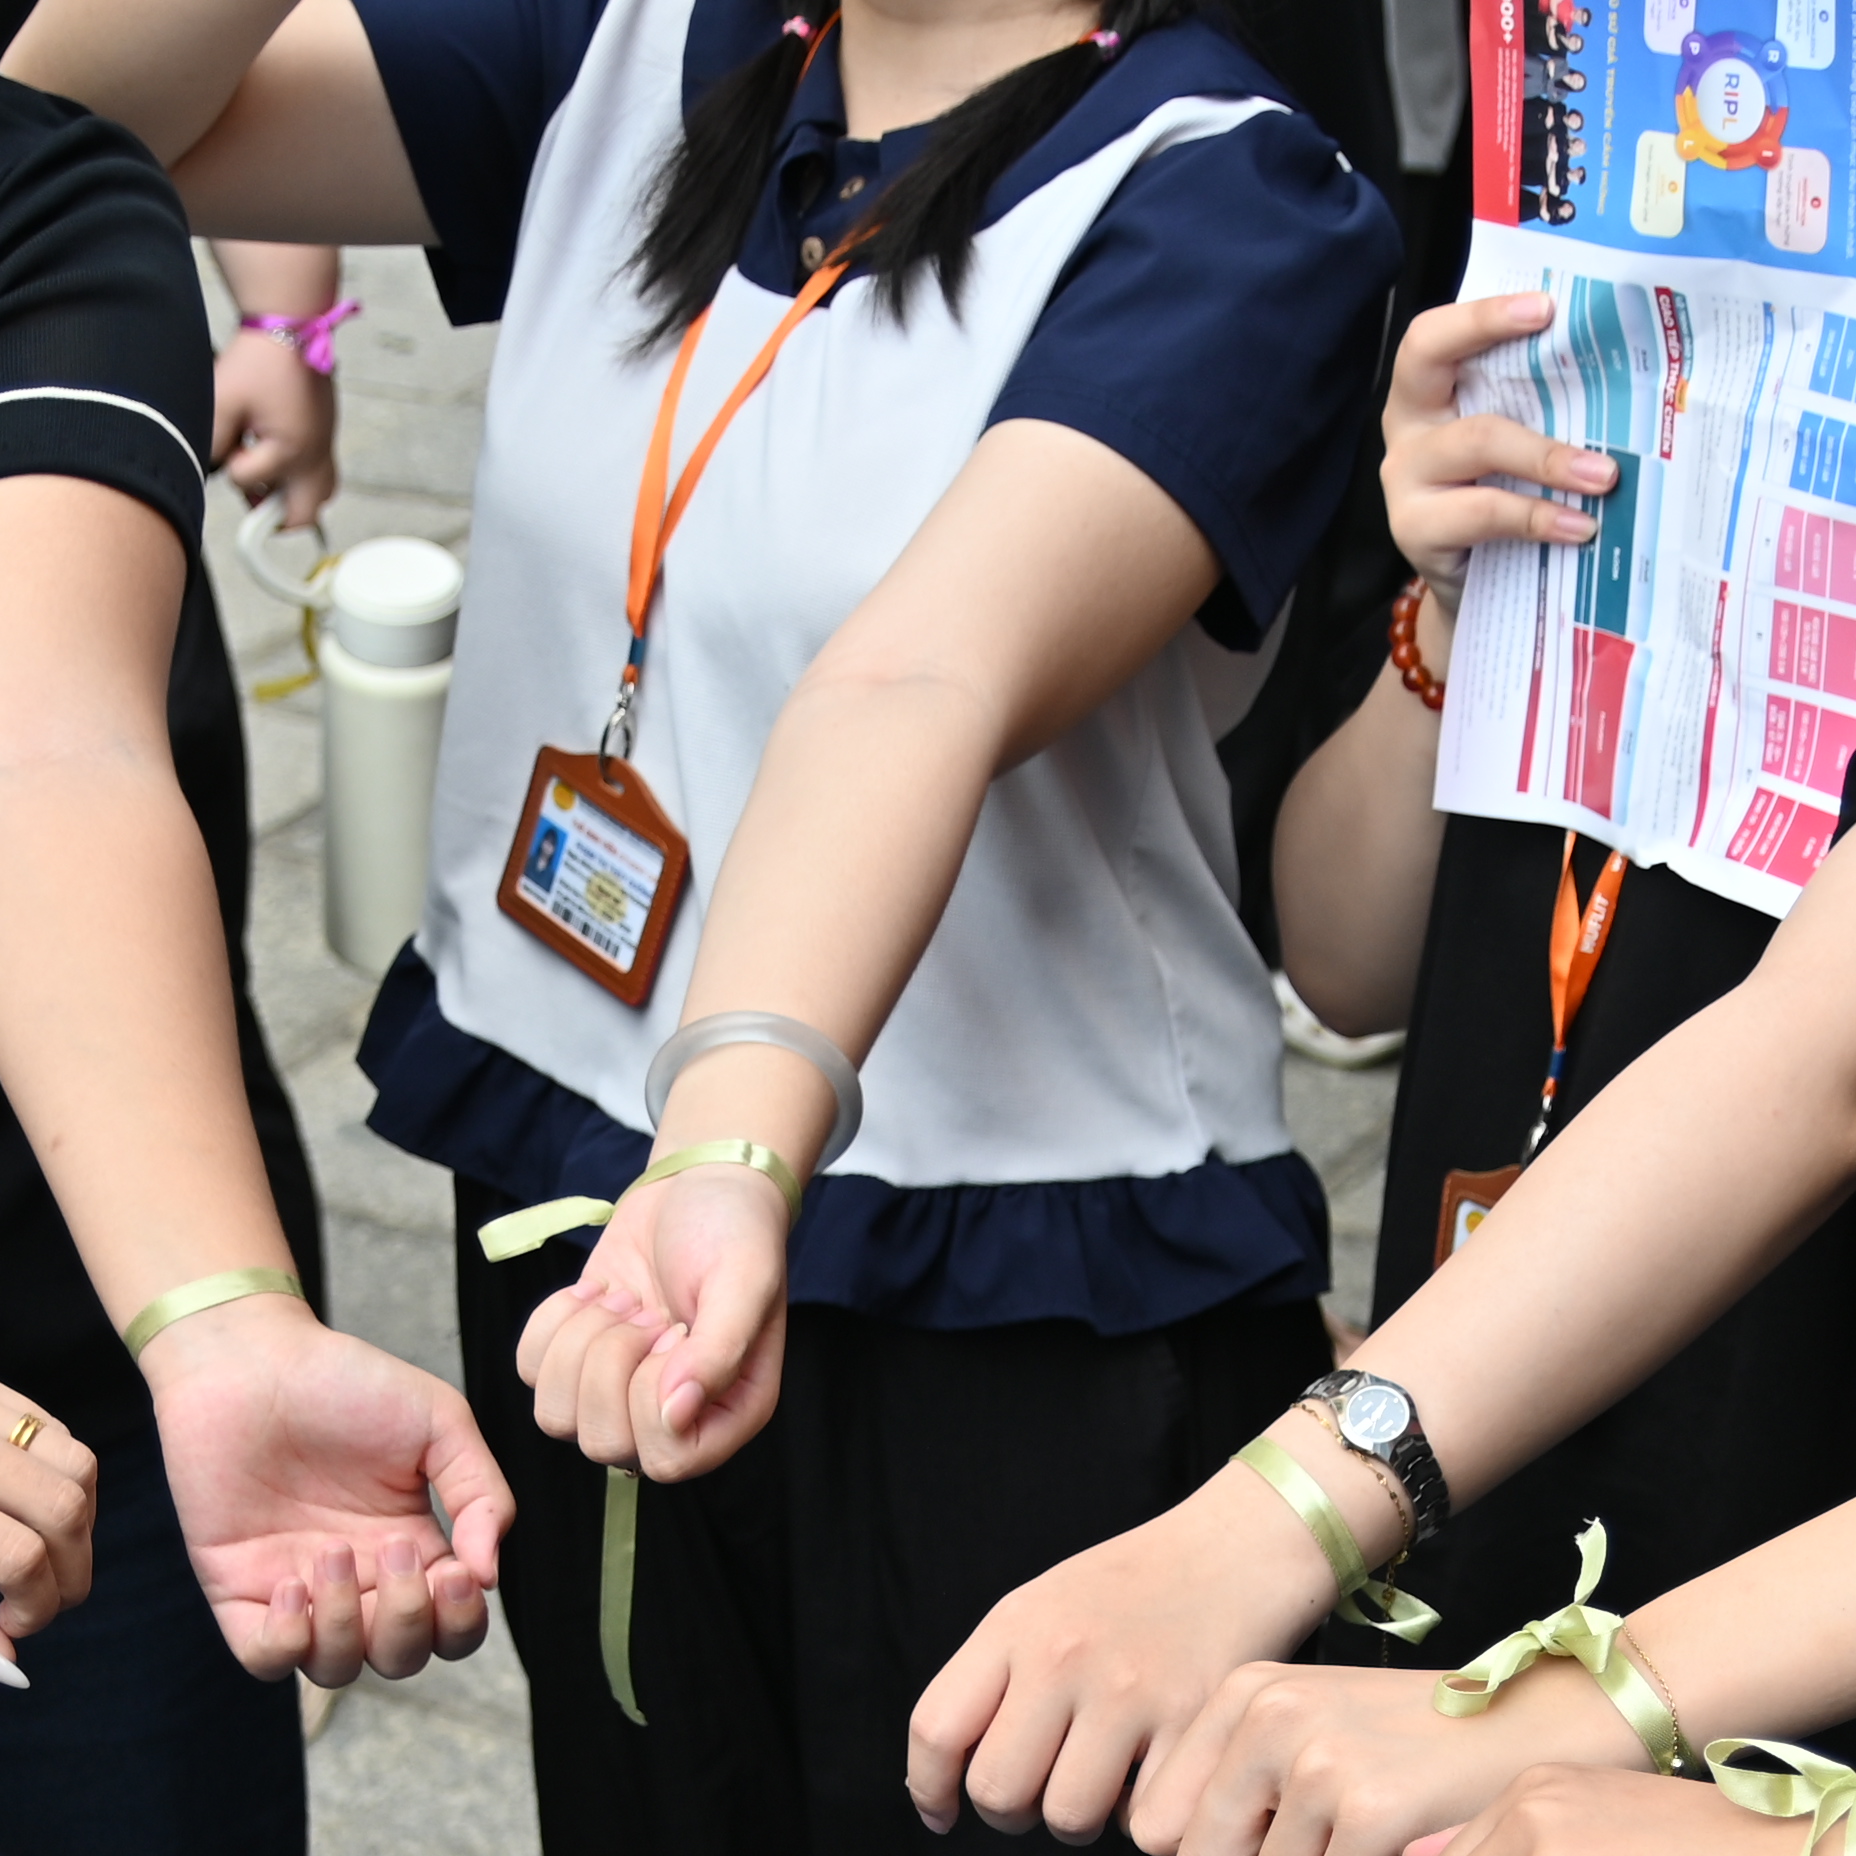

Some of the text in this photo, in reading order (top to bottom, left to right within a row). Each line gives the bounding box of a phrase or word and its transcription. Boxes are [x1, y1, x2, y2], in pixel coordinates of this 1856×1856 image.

[1688, 42, 1701, 56] P
[1767, 50, 1780, 64] R
[1722, 73, 1741, 130] RIPL
